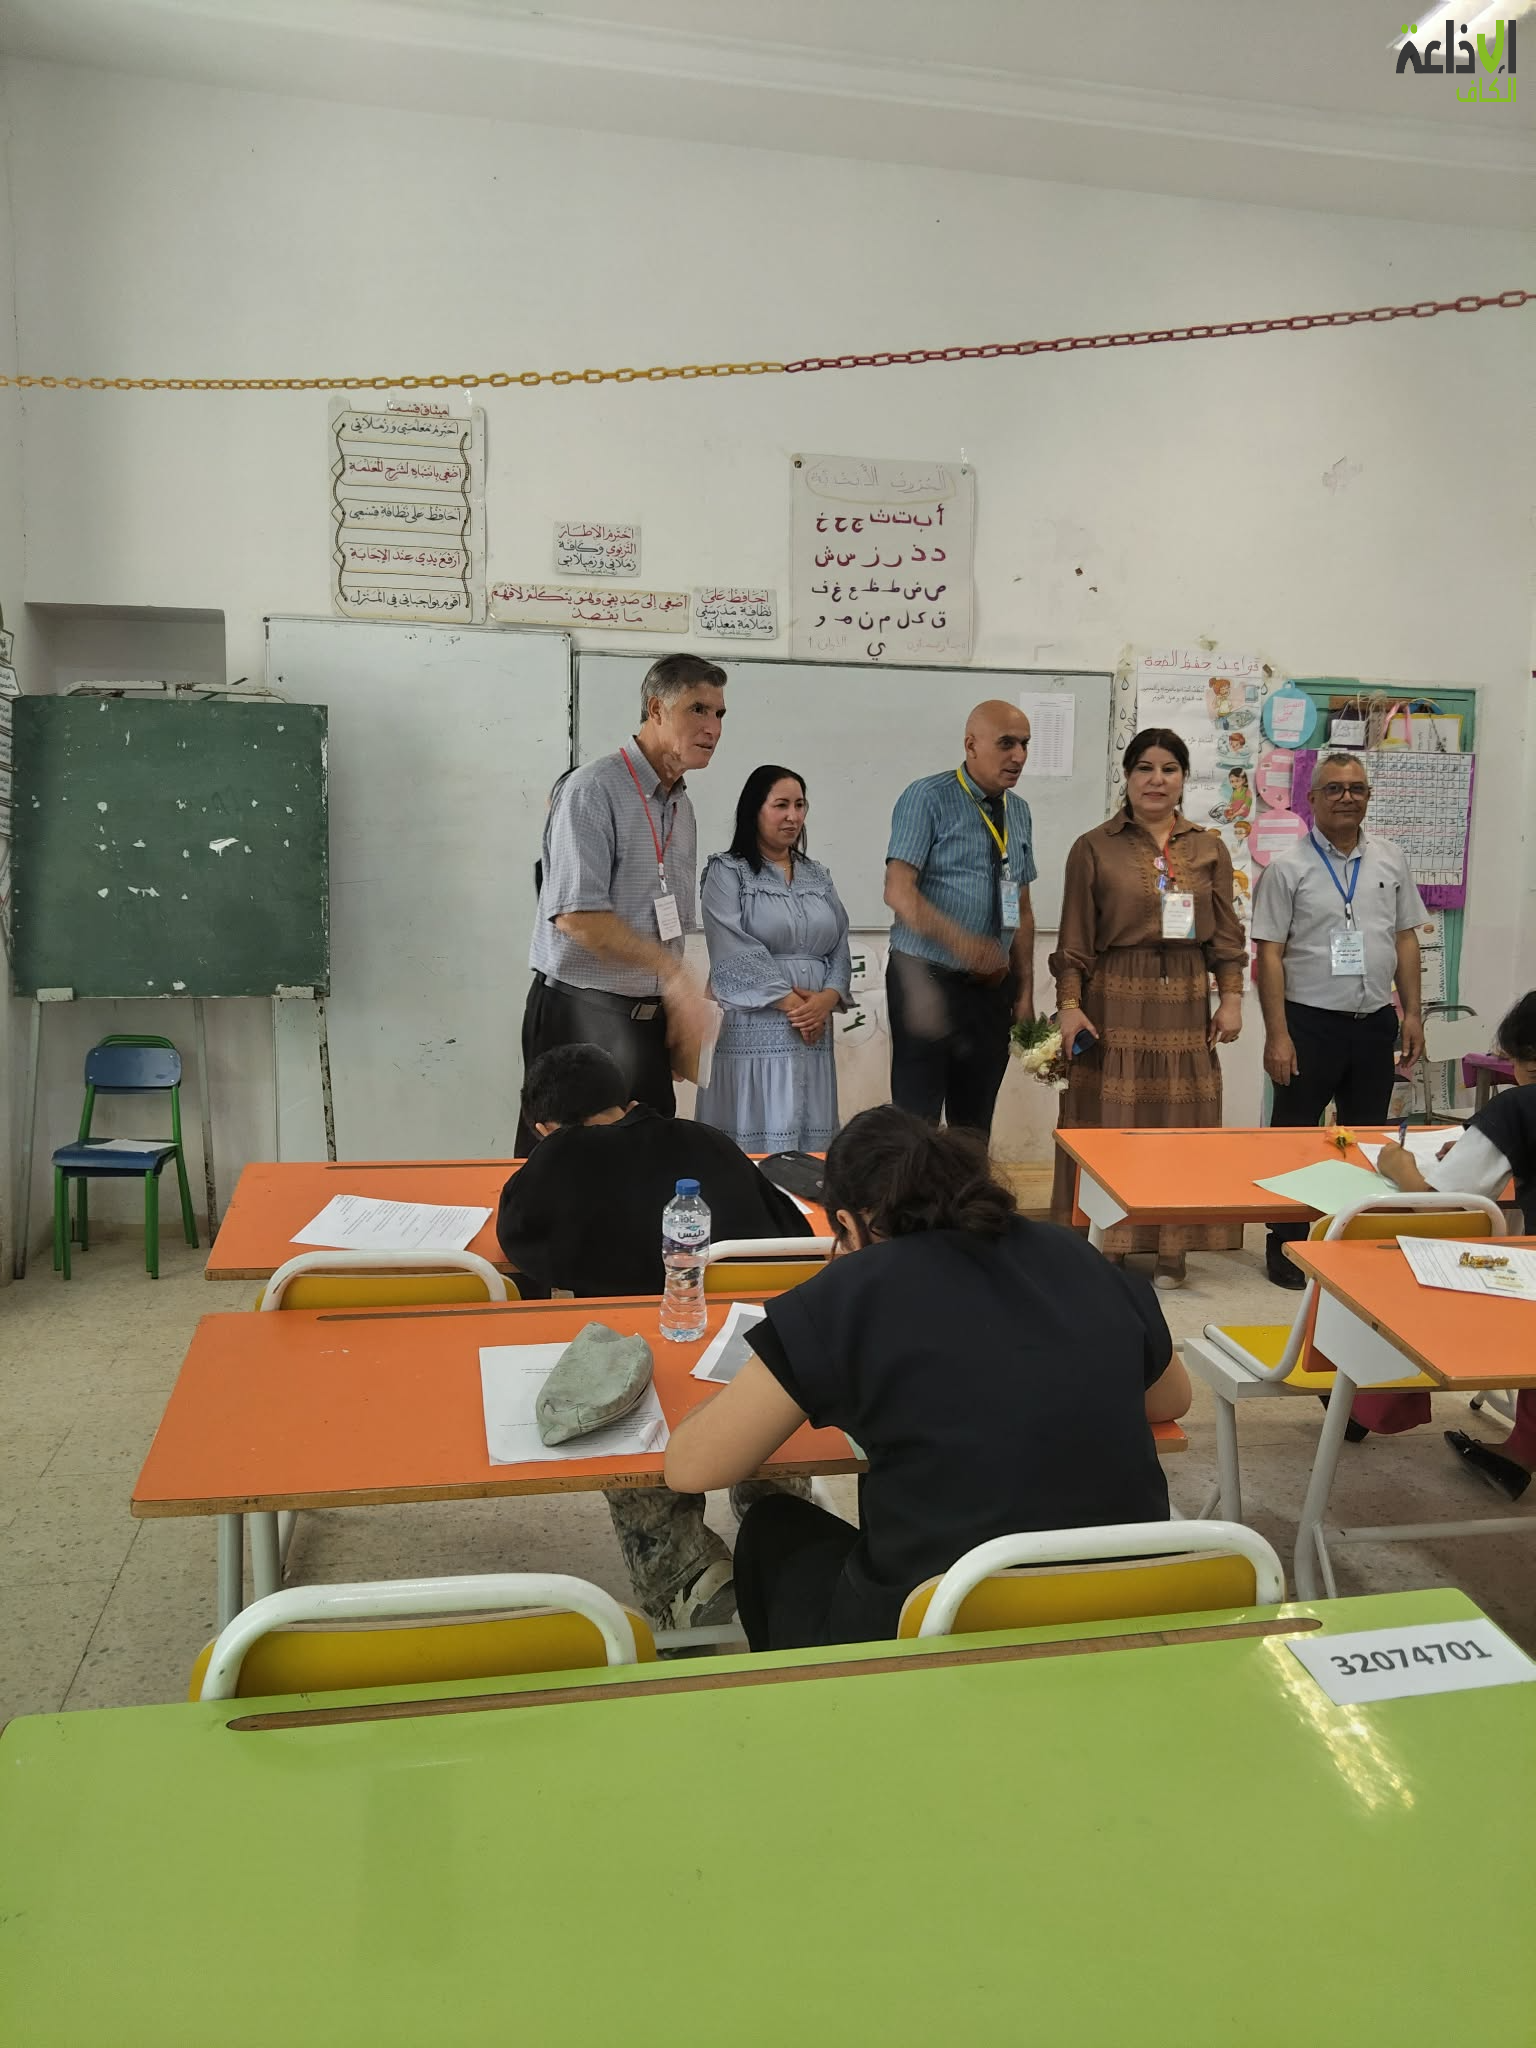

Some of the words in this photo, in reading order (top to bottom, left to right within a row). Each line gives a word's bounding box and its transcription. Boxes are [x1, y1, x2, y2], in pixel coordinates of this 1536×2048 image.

[816, 512, 829, 532] خ
[870, 510, 890, 523] ث
[892, 512, 911, 523] ت
[936, 504, 944, 525] أ
[835, 517, 848, 532] ح
[852, 517, 864, 533] ج
[913, 515, 932, 532] ب
[815, 546, 834, 567] ش
[837, 553, 856, 566] س
[860, 547, 880, 567] ز
[882, 553, 902, 567] ر
[911, 544, 926, 561] ذ
[931, 548, 946, 561] د
[812, 581, 828, 593] ف
[832, 582, 841, 602] غ
[849, 586, 858, 600] ع
[861, 578, 879, 592] ظ
[881, 579, 900, 592] ط
[904, 582, 922, 600] ض
[925, 584, 946, 601] ص
[572, 608, 619, 622] يقصد
[624, 608, 643, 622] ما
[814, 616, 826, 627] و
[859, 612, 874, 630] ن
[897, 611, 910, 629] ل
[931, 612, 946, 628] ق
[879, 616, 891, 633] م
[867, 642, 886, 660] ي
[1180, 651, 1211, 670] حفظ
[1330, 1640, 1492, 1676] 32074701
